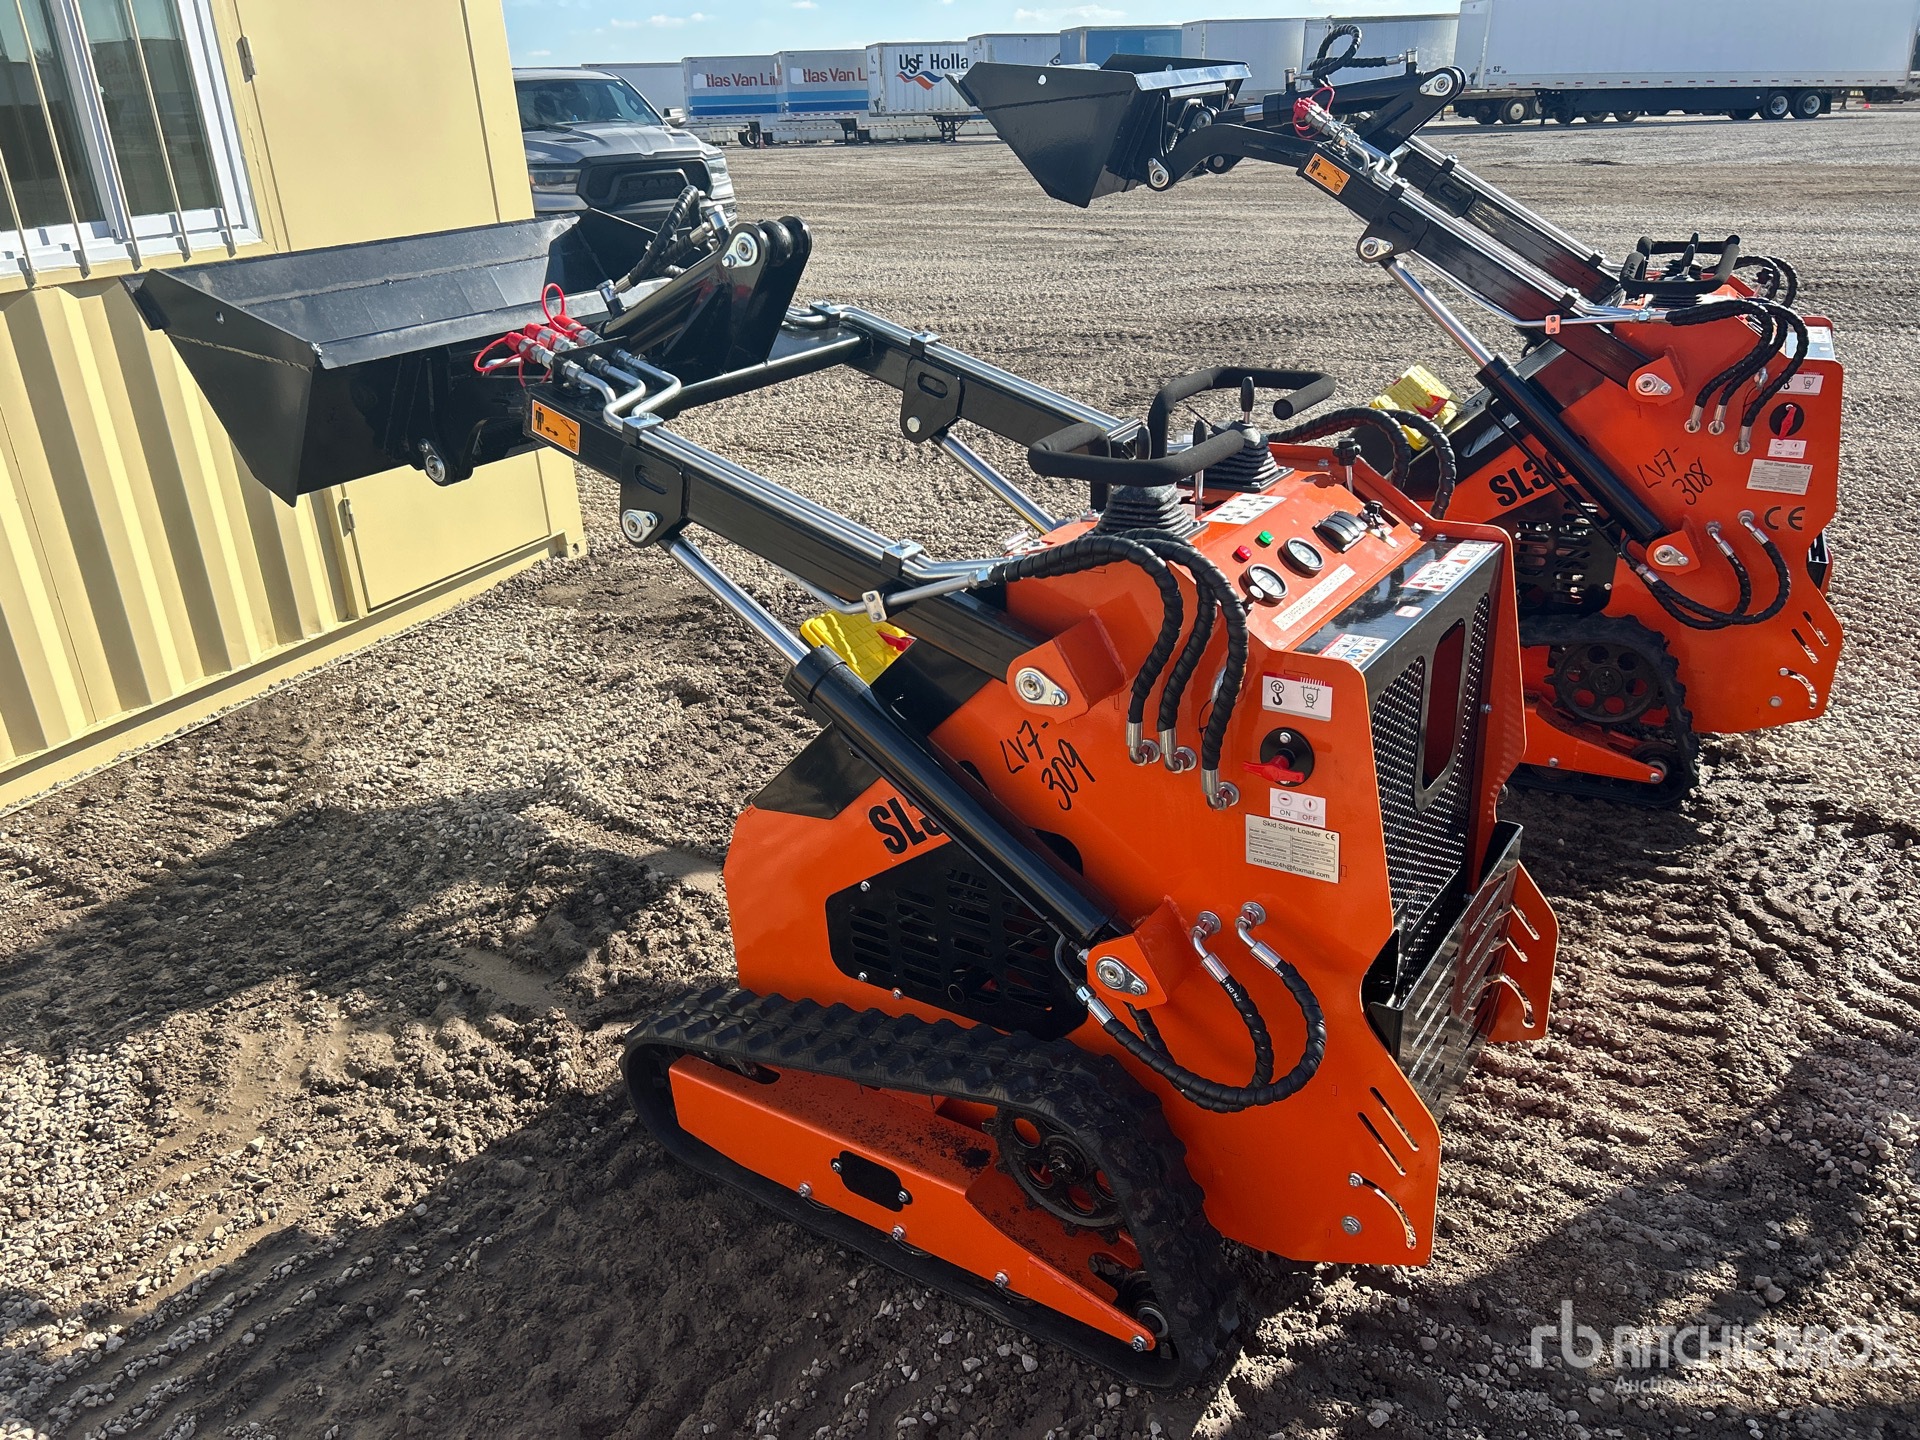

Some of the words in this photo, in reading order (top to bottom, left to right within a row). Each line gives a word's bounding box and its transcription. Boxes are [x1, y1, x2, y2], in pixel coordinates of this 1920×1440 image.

[899, 53, 924, 74] USF
[705, 73, 732, 88] tlas
[731, 73, 758, 87] Van
[803, 68, 828, 83] tlas
[828, 67, 855, 82] Van
[1672, 456, 1713, 505] 308
[1764, 506, 1806, 531] CE
[1041, 738, 1096, 811] 309
[1279, 809, 1291, 817] ON
[1302, 814, 1318, 822] OFF
[1262, 820, 1277, 829] Skid
[1278, 822, 1296, 832] Steer
[1297, 827, 1321, 838] Loader
